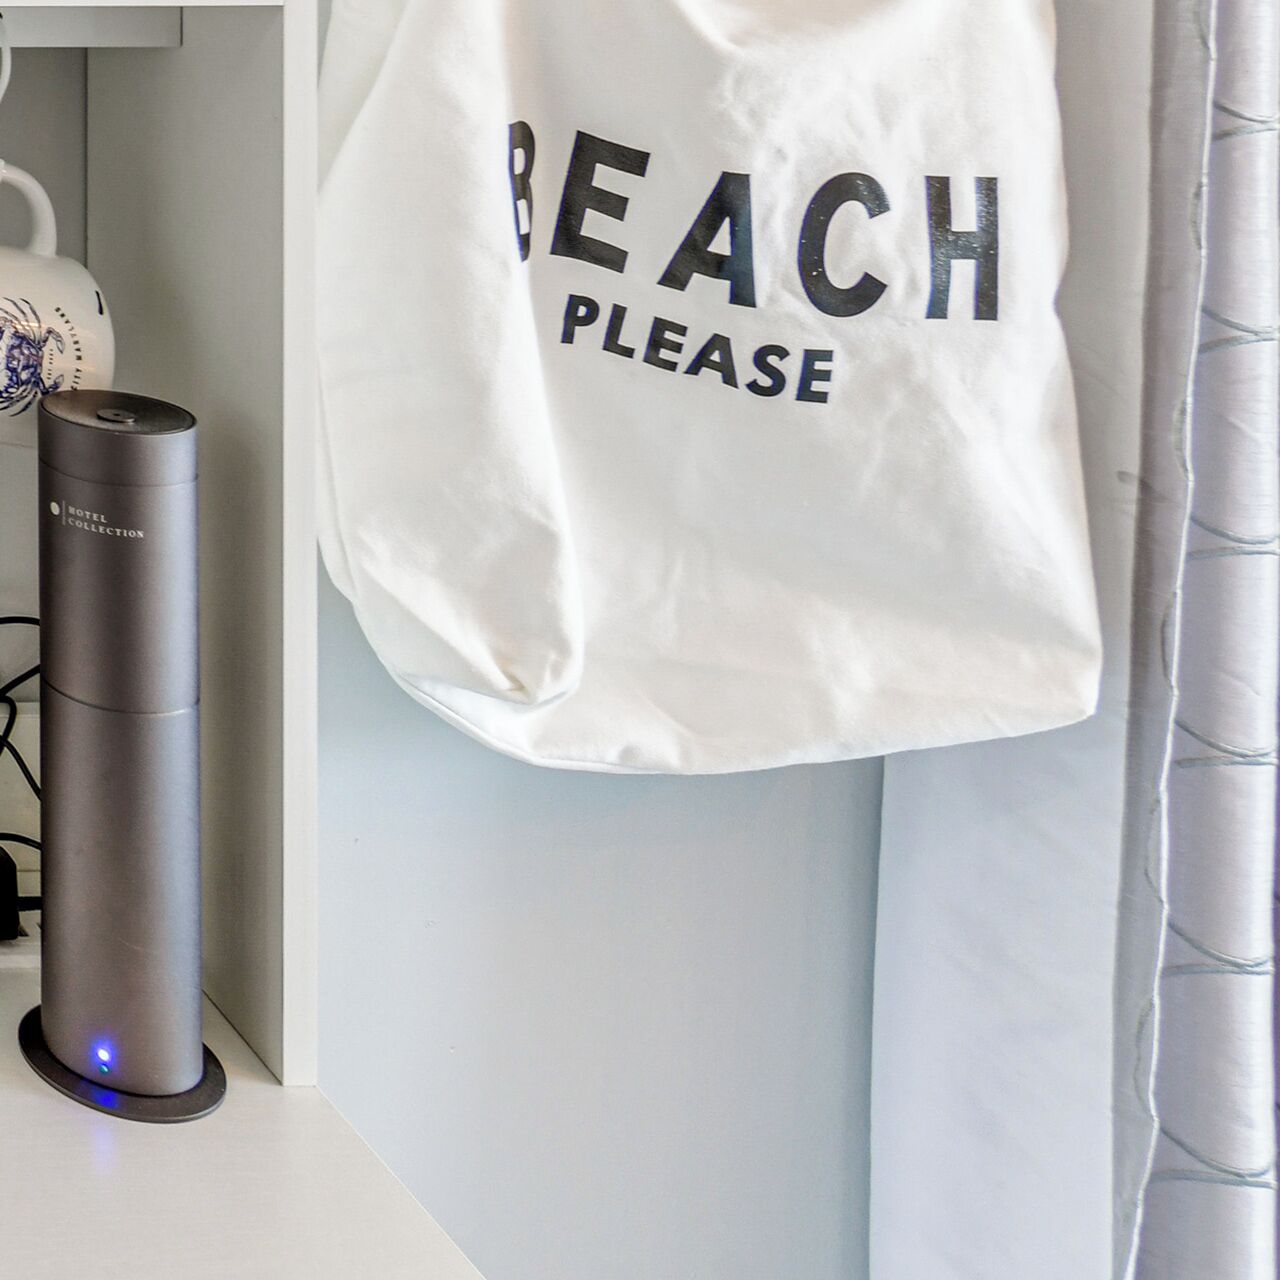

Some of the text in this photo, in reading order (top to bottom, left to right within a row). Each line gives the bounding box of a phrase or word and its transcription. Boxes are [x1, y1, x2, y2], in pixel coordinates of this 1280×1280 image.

[508, 120, 999, 321] BEACH
[561, 293, 833, 403] PLEASE
[68, 506, 107, 522] HOTEL
[68, 518, 144, 538] COLLECTION
